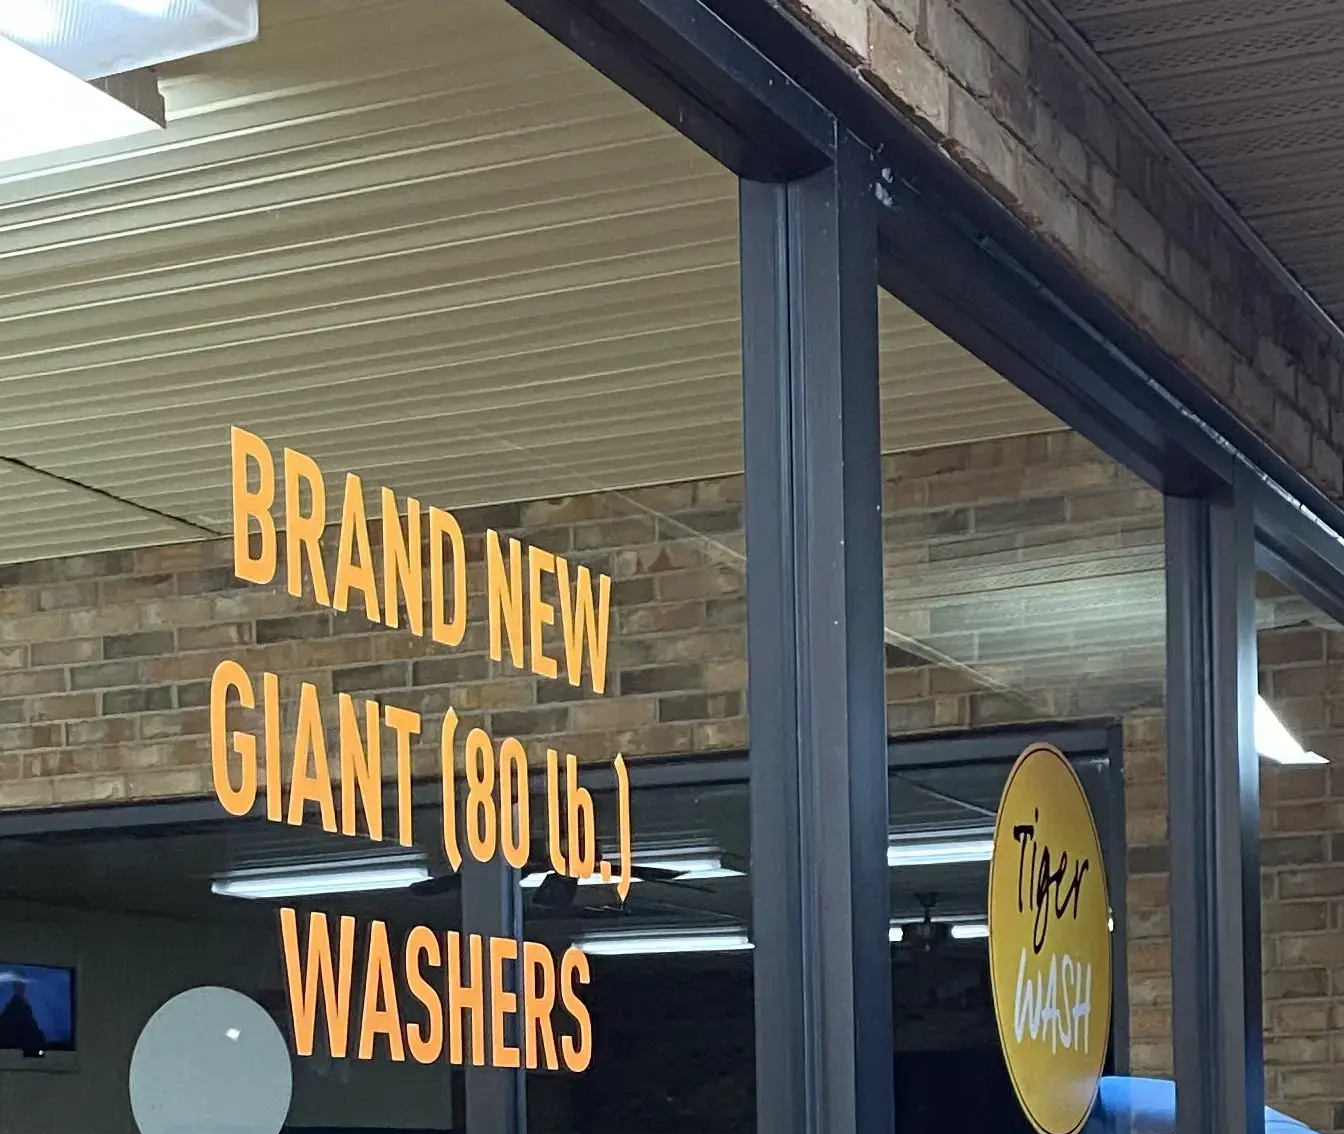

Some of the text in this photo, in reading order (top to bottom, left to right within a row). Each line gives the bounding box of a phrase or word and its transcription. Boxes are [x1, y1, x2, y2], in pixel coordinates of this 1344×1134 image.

[230, 425, 612, 695] BRAND NEW
[210, 660, 633, 902] GIANT (80 lb.)
[1013, 806, 1089, 955] Tiger
[280, 907, 593, 1073] WASHERS
[1014, 947, 1092, 1055] WASH
